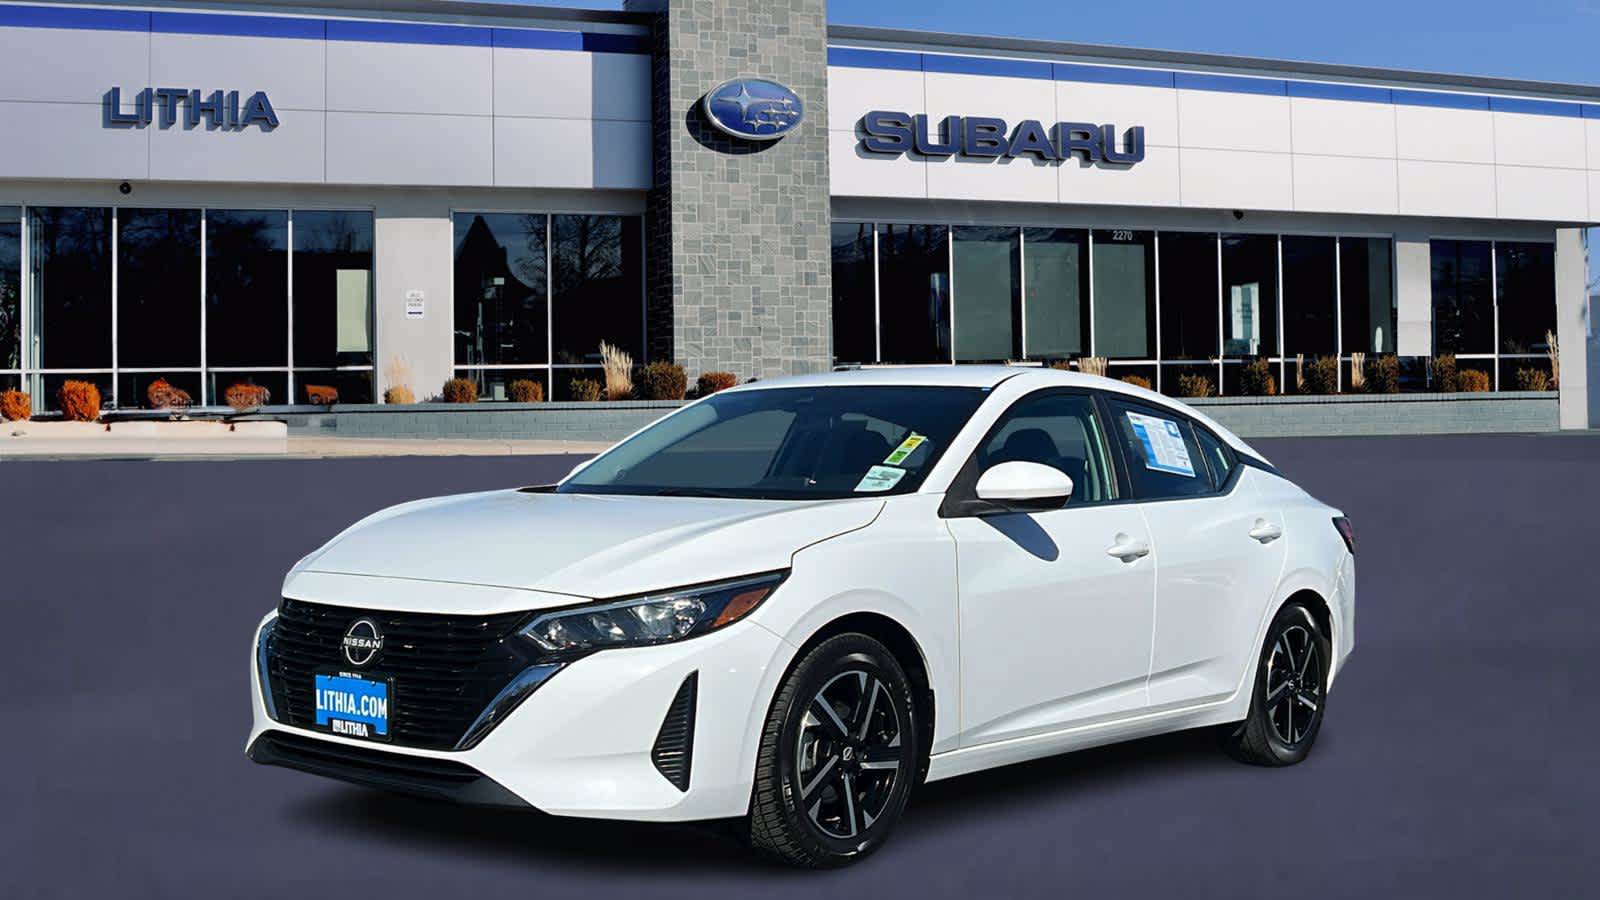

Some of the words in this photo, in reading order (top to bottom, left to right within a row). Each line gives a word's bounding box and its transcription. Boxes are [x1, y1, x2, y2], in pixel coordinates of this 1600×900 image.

[103, 86, 279, 131] LITHIA
[856, 110, 1145, 168] SUBARU
[1112, 230, 1133, 241] 2270
[343, 636, 381, 649] NISSAN
[315, 688, 388, 720] LITHIA.COM
[340, 720, 369, 737] LITHIA
